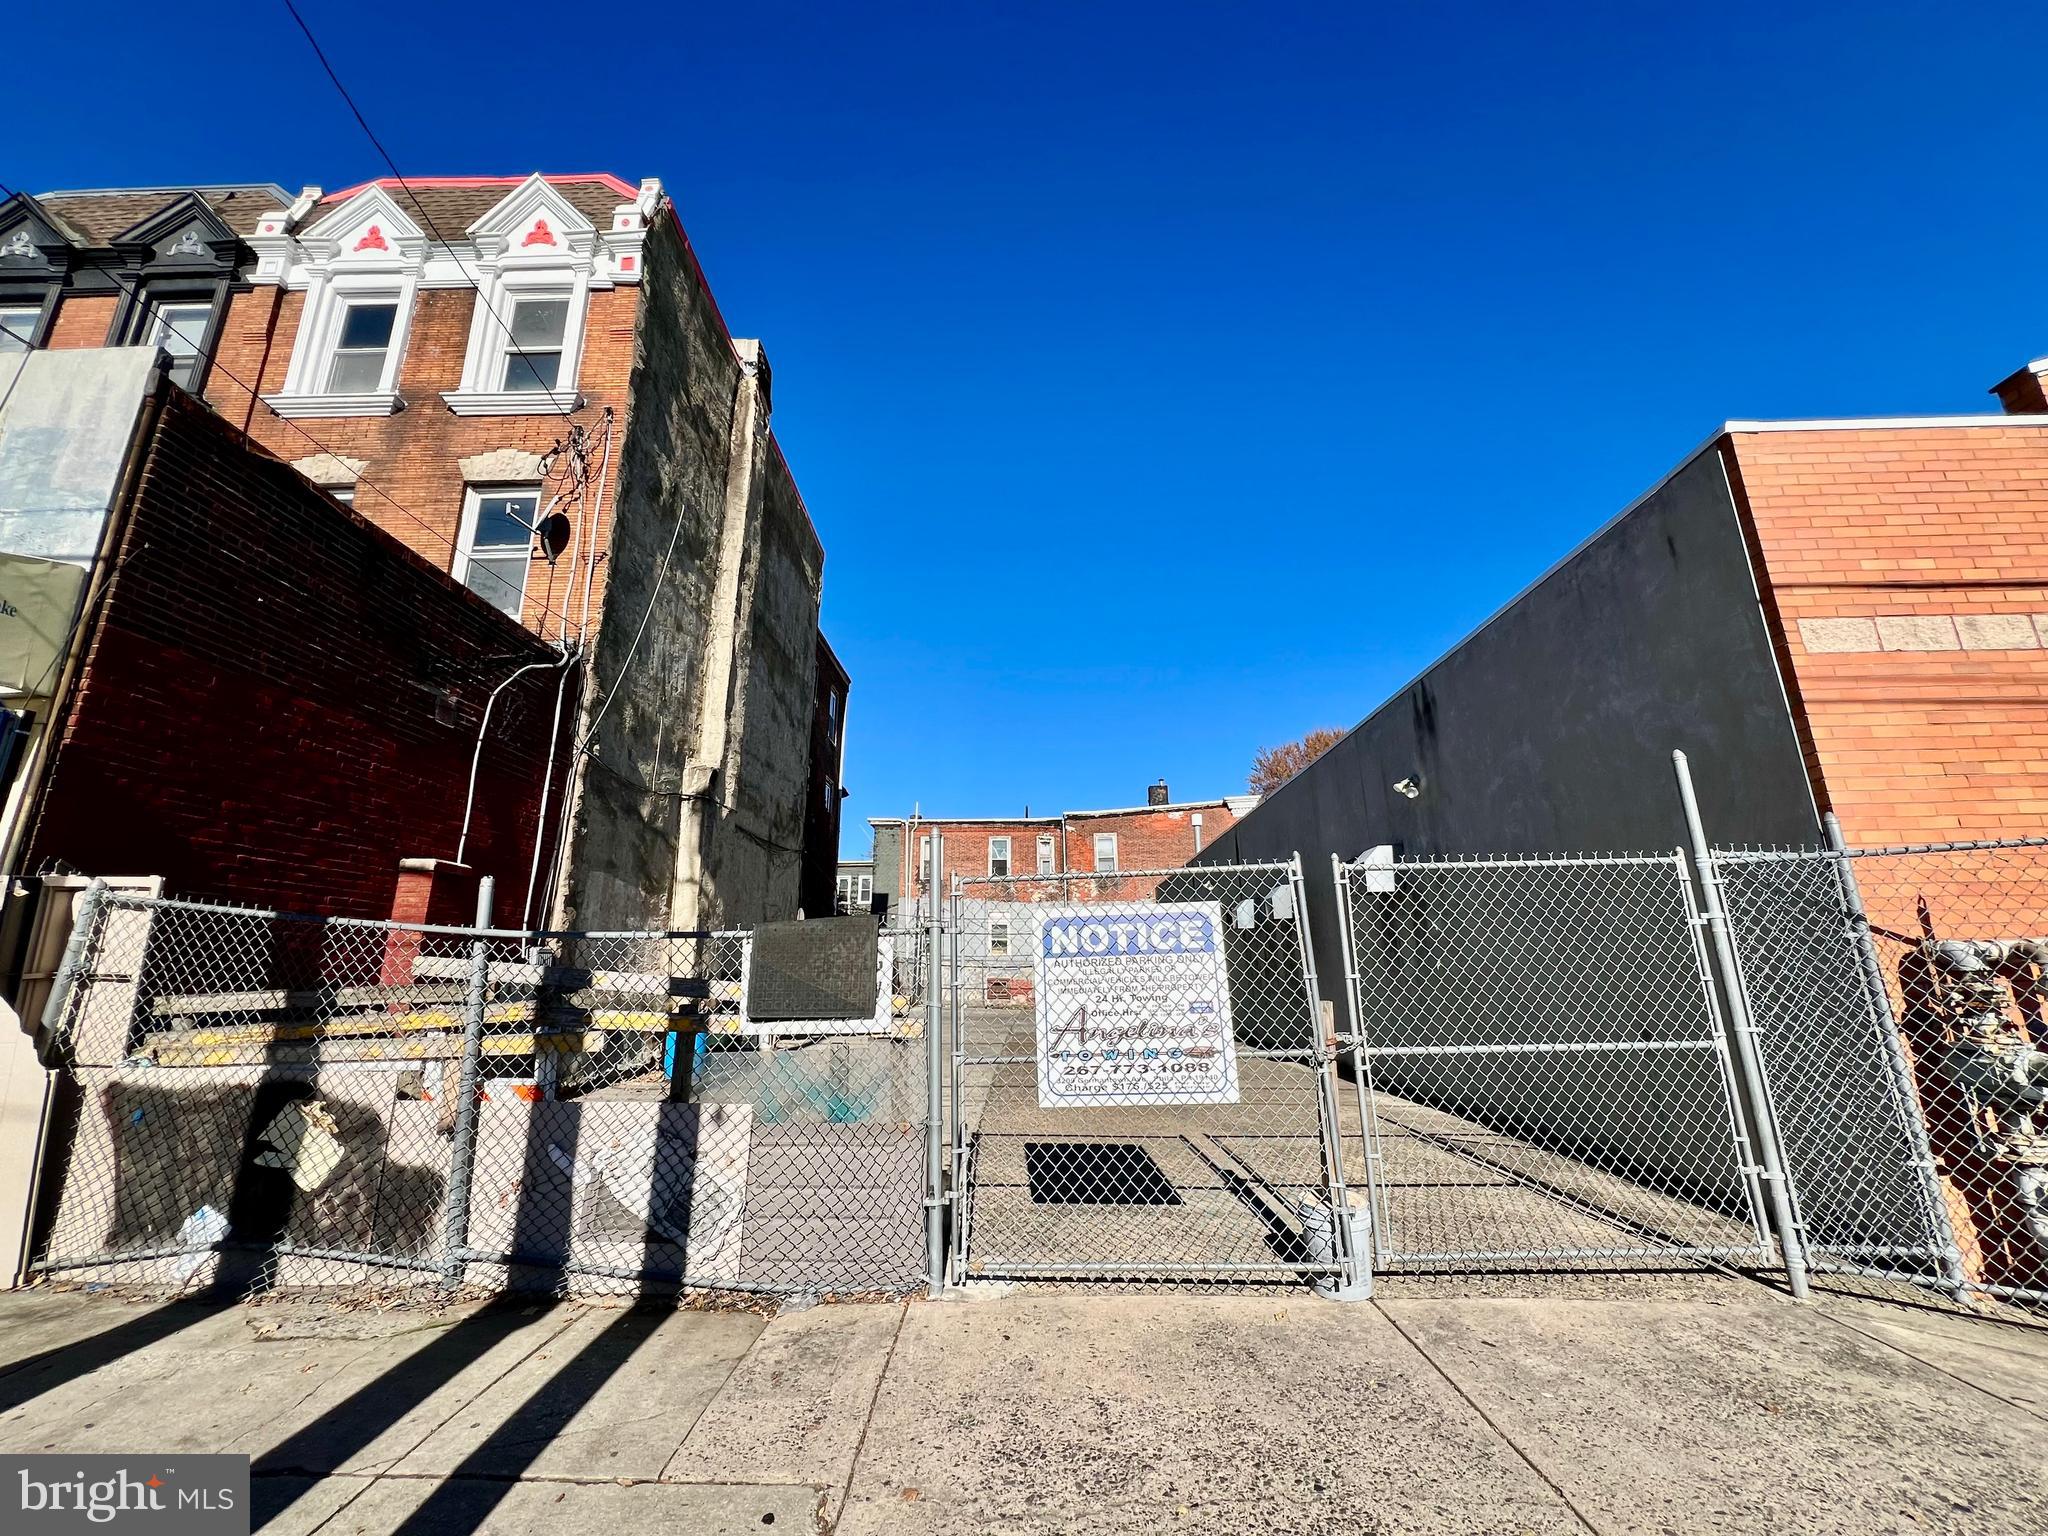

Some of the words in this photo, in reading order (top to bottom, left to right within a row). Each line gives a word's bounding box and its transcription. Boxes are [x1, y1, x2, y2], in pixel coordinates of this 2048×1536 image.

[0, 600, 17, 617] ke
[1050, 920, 1206, 954] NOTICE
[1054, 957, 1122, 968] AUTHORIZED
[1126, 955, 1174, 965] PARKING
[1177, 954, 1205, 964] ONLY
[1082, 967, 1125, 975] ILLEGALLY
[1128, 965, 1162, 973] PARKED
[1047, 977, 1102, 986] COMMERCIAL
[1105, 975, 1146, 983] VEHICLES
[1058, 986, 1111, 994] IMMEDIATELY
[1115, 985, 1138, 993] FROM
[1159, 983, 1204, 991] PROPERTY
[1095, 995, 1108, 1003] 24
[1130, 993, 1168, 1003] Towing
[1091, 1009, 1119, 1017] Office
[1049, 1003, 1220, 1052] Angelina's
[1058, 1047, 1184, 1062] TOWING
[1063, 1062, 1210, 1076] 267-773-1088
[1065, 1083, 1107, 1094] Charge
